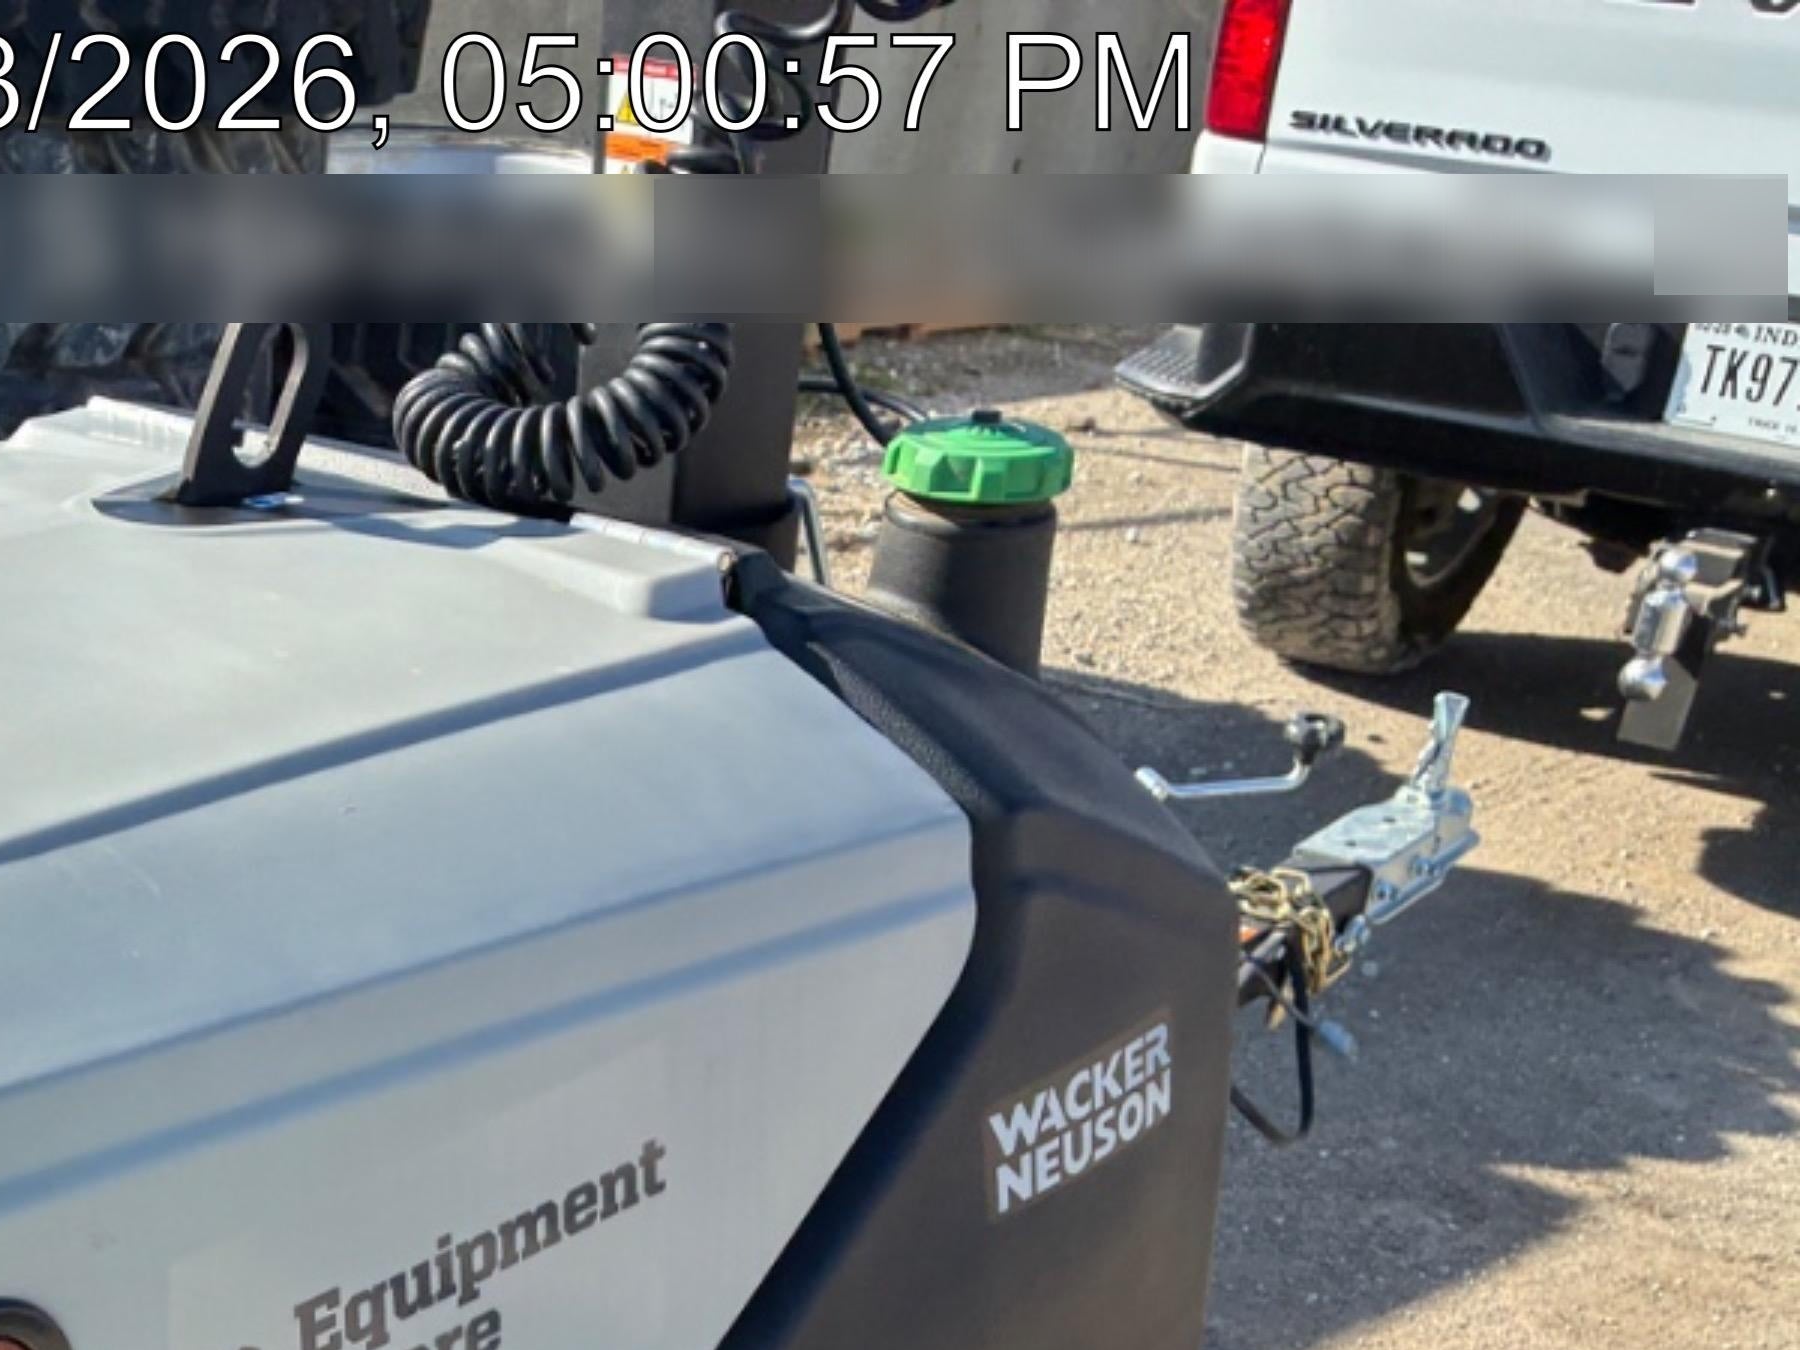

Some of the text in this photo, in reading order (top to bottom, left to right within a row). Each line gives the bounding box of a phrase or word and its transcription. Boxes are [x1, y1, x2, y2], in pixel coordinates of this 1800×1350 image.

[1288, 109, 1552, 163] SILVERADO
[1700, 343, 1800, 410] TK97
[988, 1020, 1173, 1157] WACKER
[995, 1070, 1173, 1216] NEUSON
